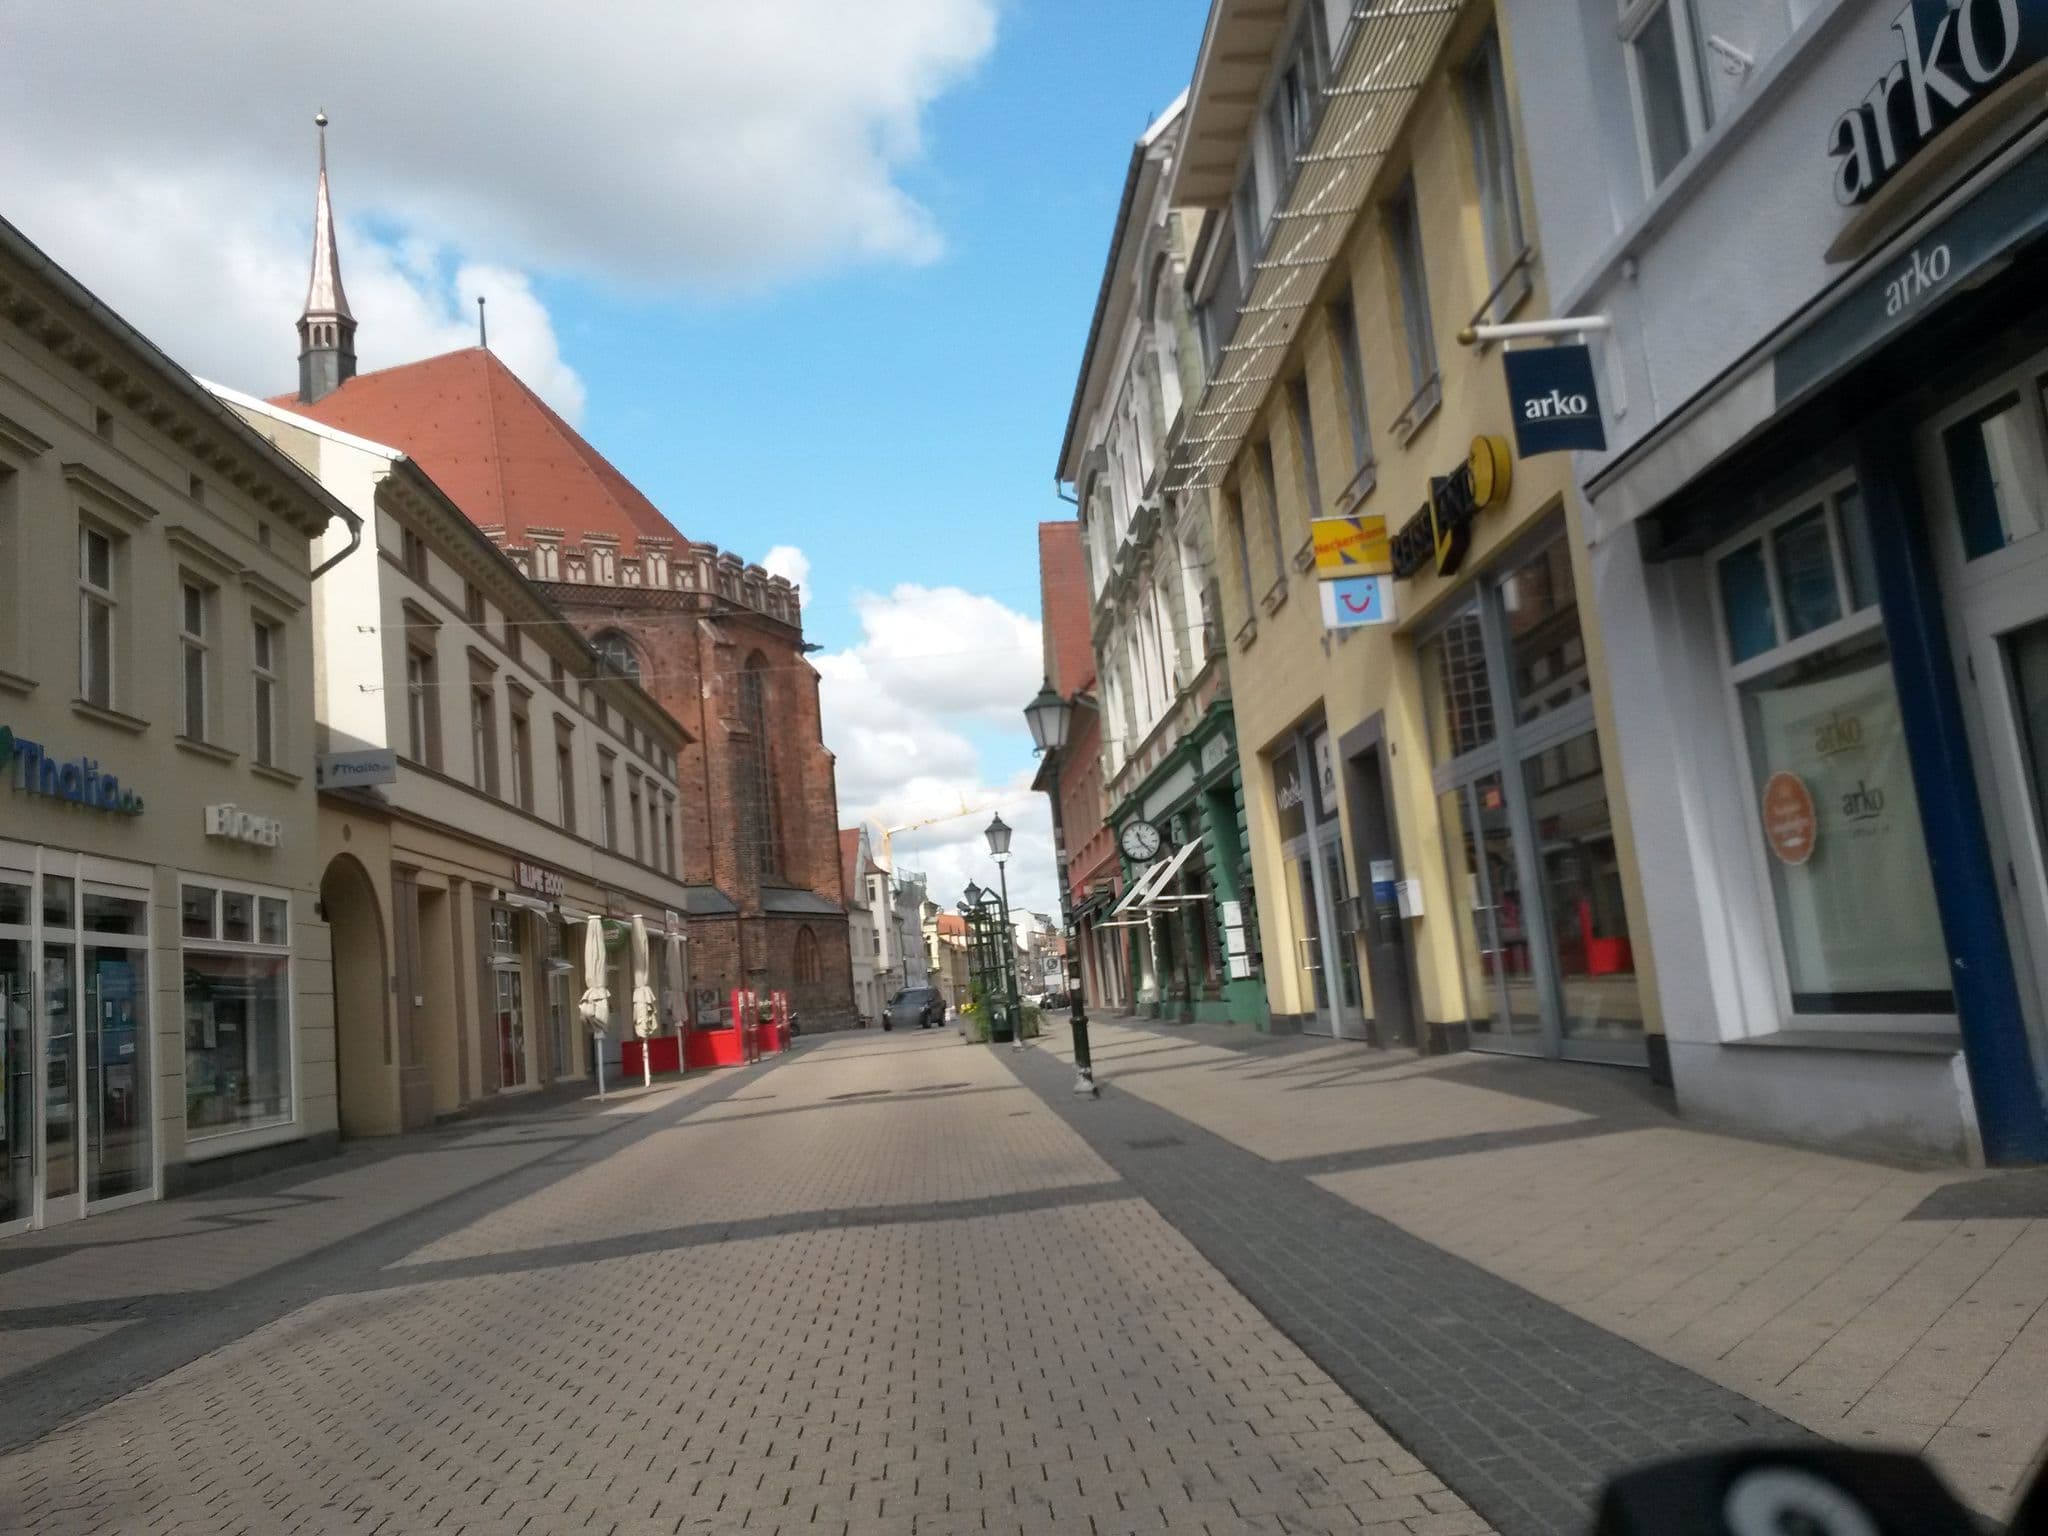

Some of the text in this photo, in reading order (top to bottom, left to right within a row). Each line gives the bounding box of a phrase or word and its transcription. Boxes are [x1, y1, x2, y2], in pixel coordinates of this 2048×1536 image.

[1828, 0, 2020, 207] arko
[1886, 244, 1951, 318] arko
[1524, 389, 1588, 419] arko
[1842, 779, 1885, 817] arko
